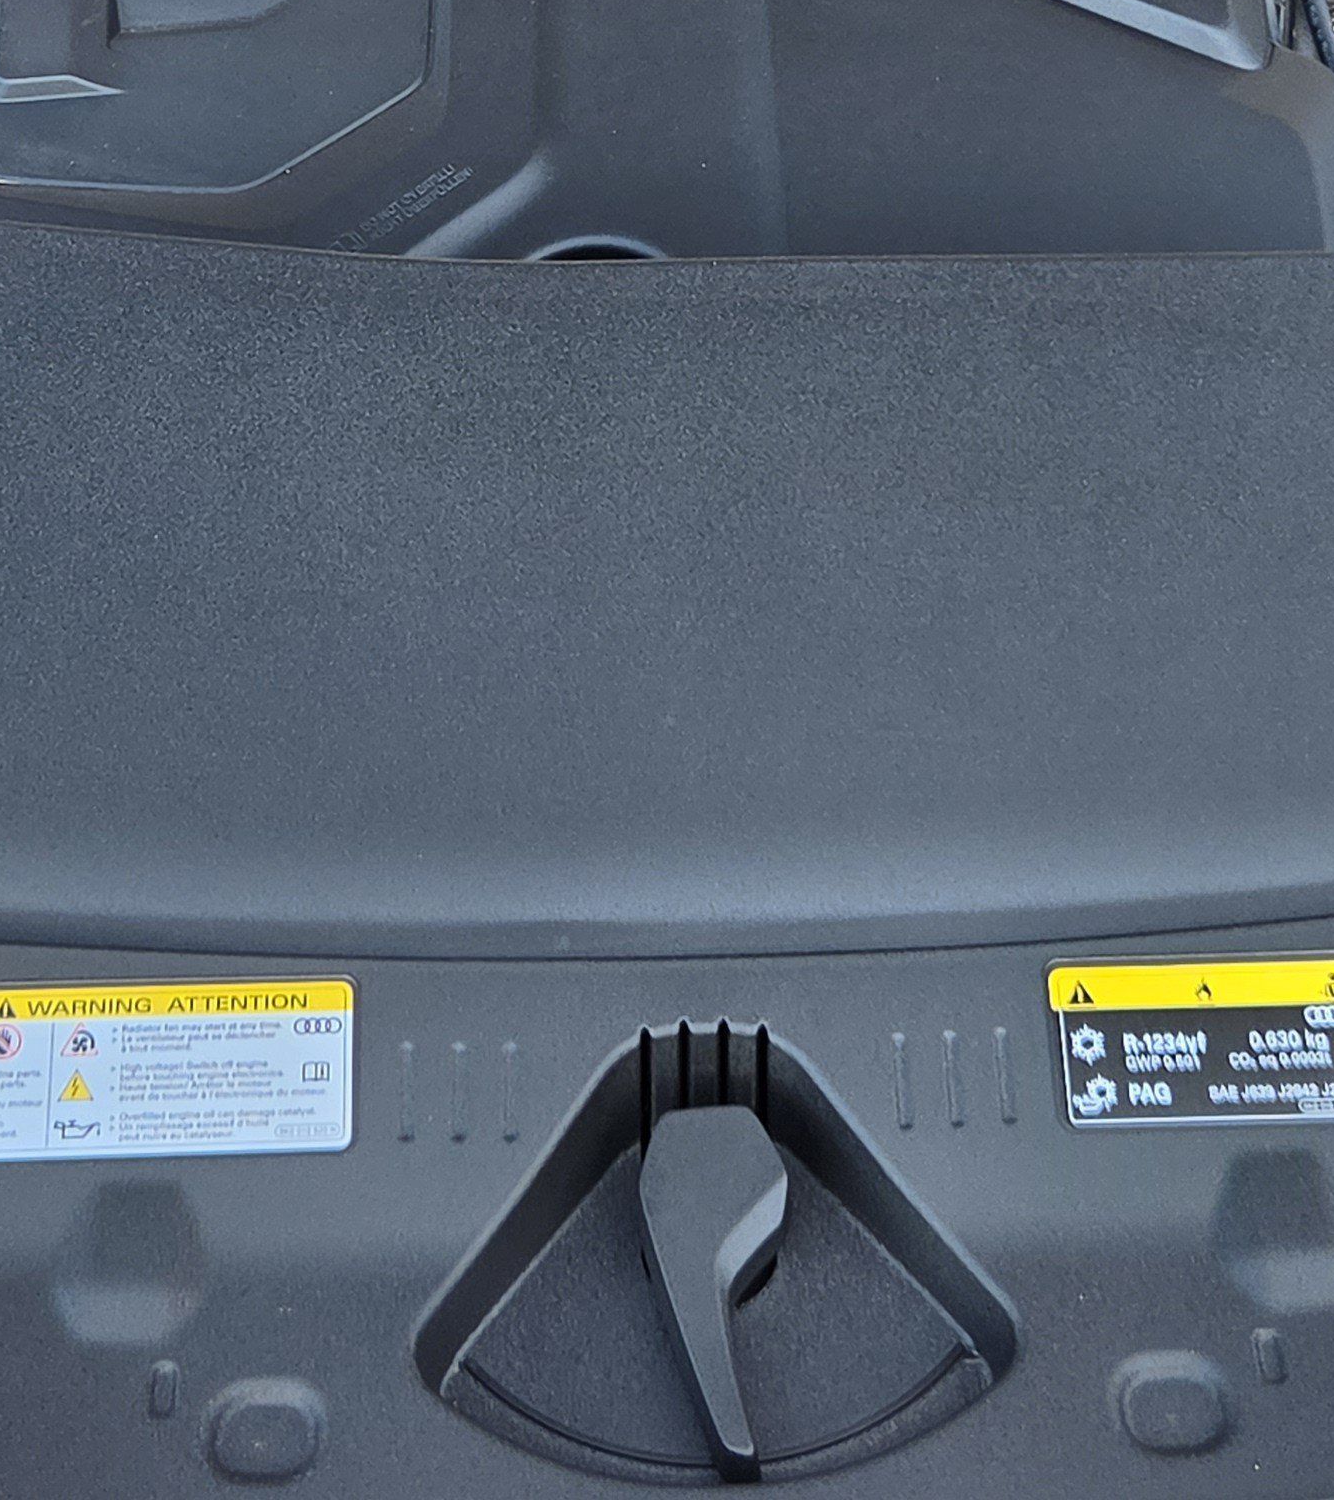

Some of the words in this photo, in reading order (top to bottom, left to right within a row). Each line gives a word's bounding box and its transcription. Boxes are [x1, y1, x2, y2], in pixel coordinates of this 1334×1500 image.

[27, 997, 152, 1017] WARNING
[167, 993, 308, 1014] ATTENTION
[1123, 1030, 1207, 1056] R-1234yf
[1305, 1028, 1330, 1051] kg
[1128, 1081, 1172, 1106] PAG
[1208, 1084, 1240, 1104] SAE
[1241, 1083, 1277, 1103] J639
